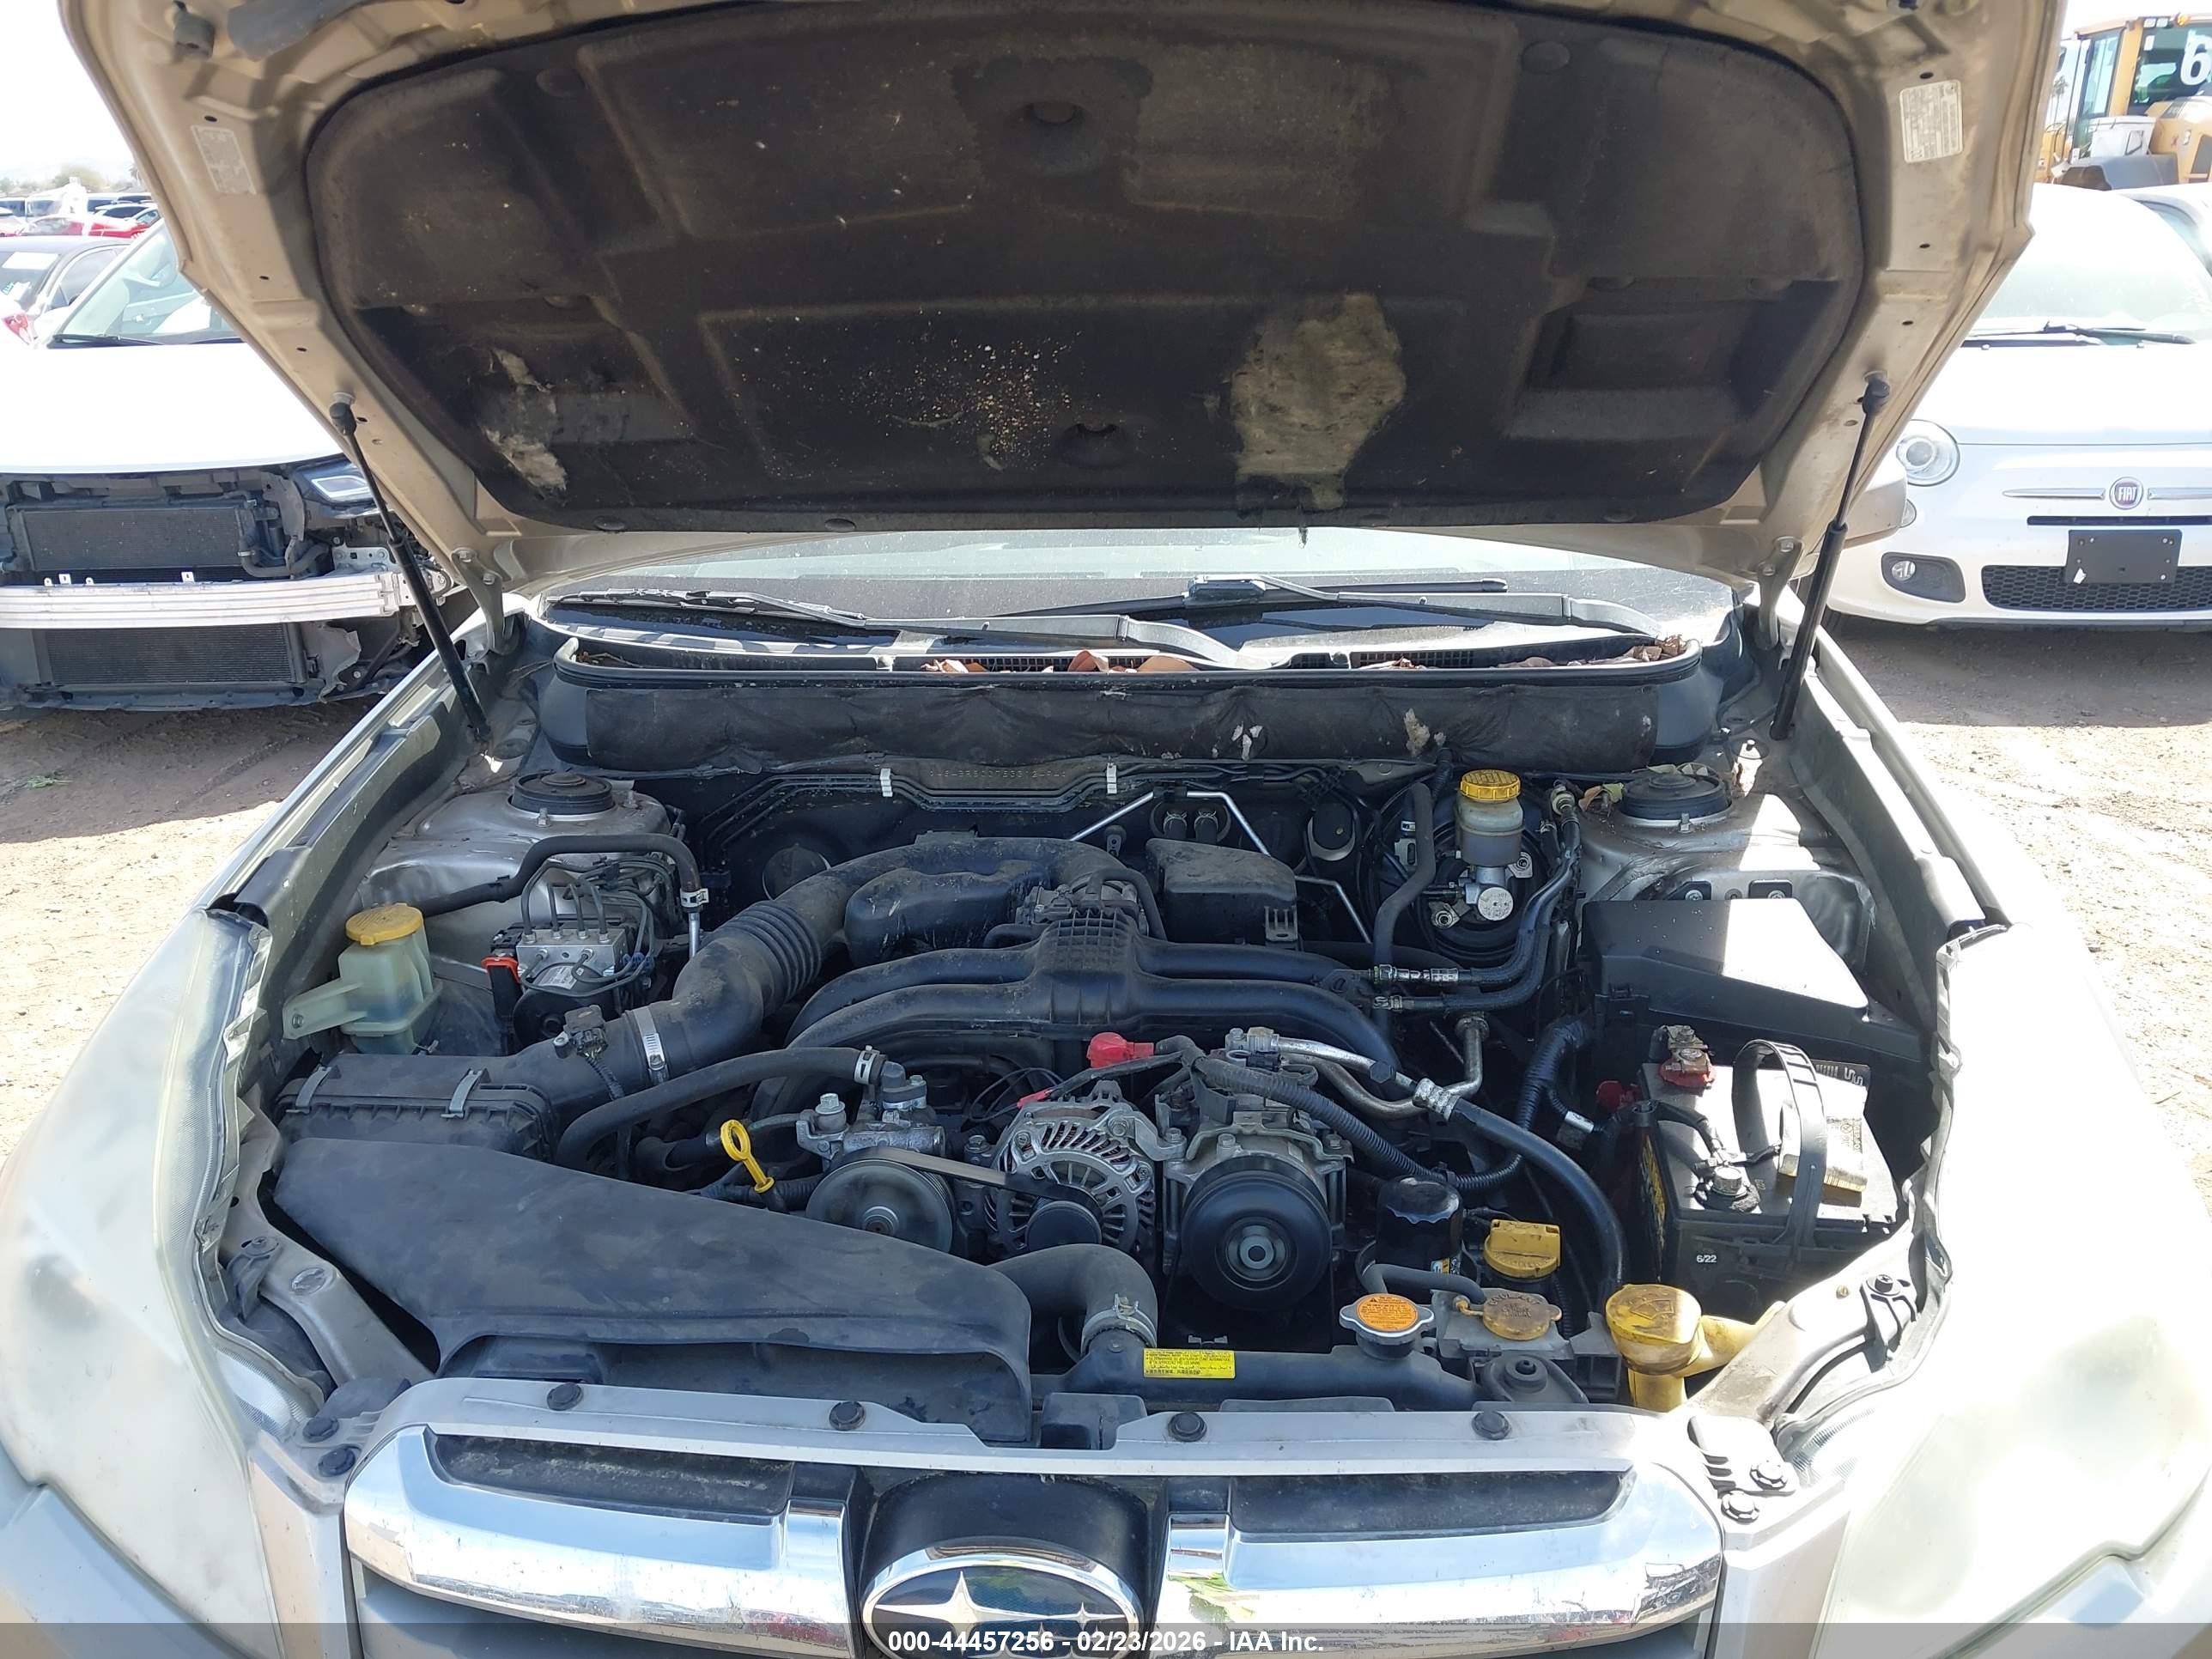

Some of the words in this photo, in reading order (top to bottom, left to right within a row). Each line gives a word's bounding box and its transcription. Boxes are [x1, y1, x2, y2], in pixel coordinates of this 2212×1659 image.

[2180, 28, 2212, 86] 6
[2118, 486, 2137, 502] FIAT
[1696, 1255, 1717, 1263] 6/22
